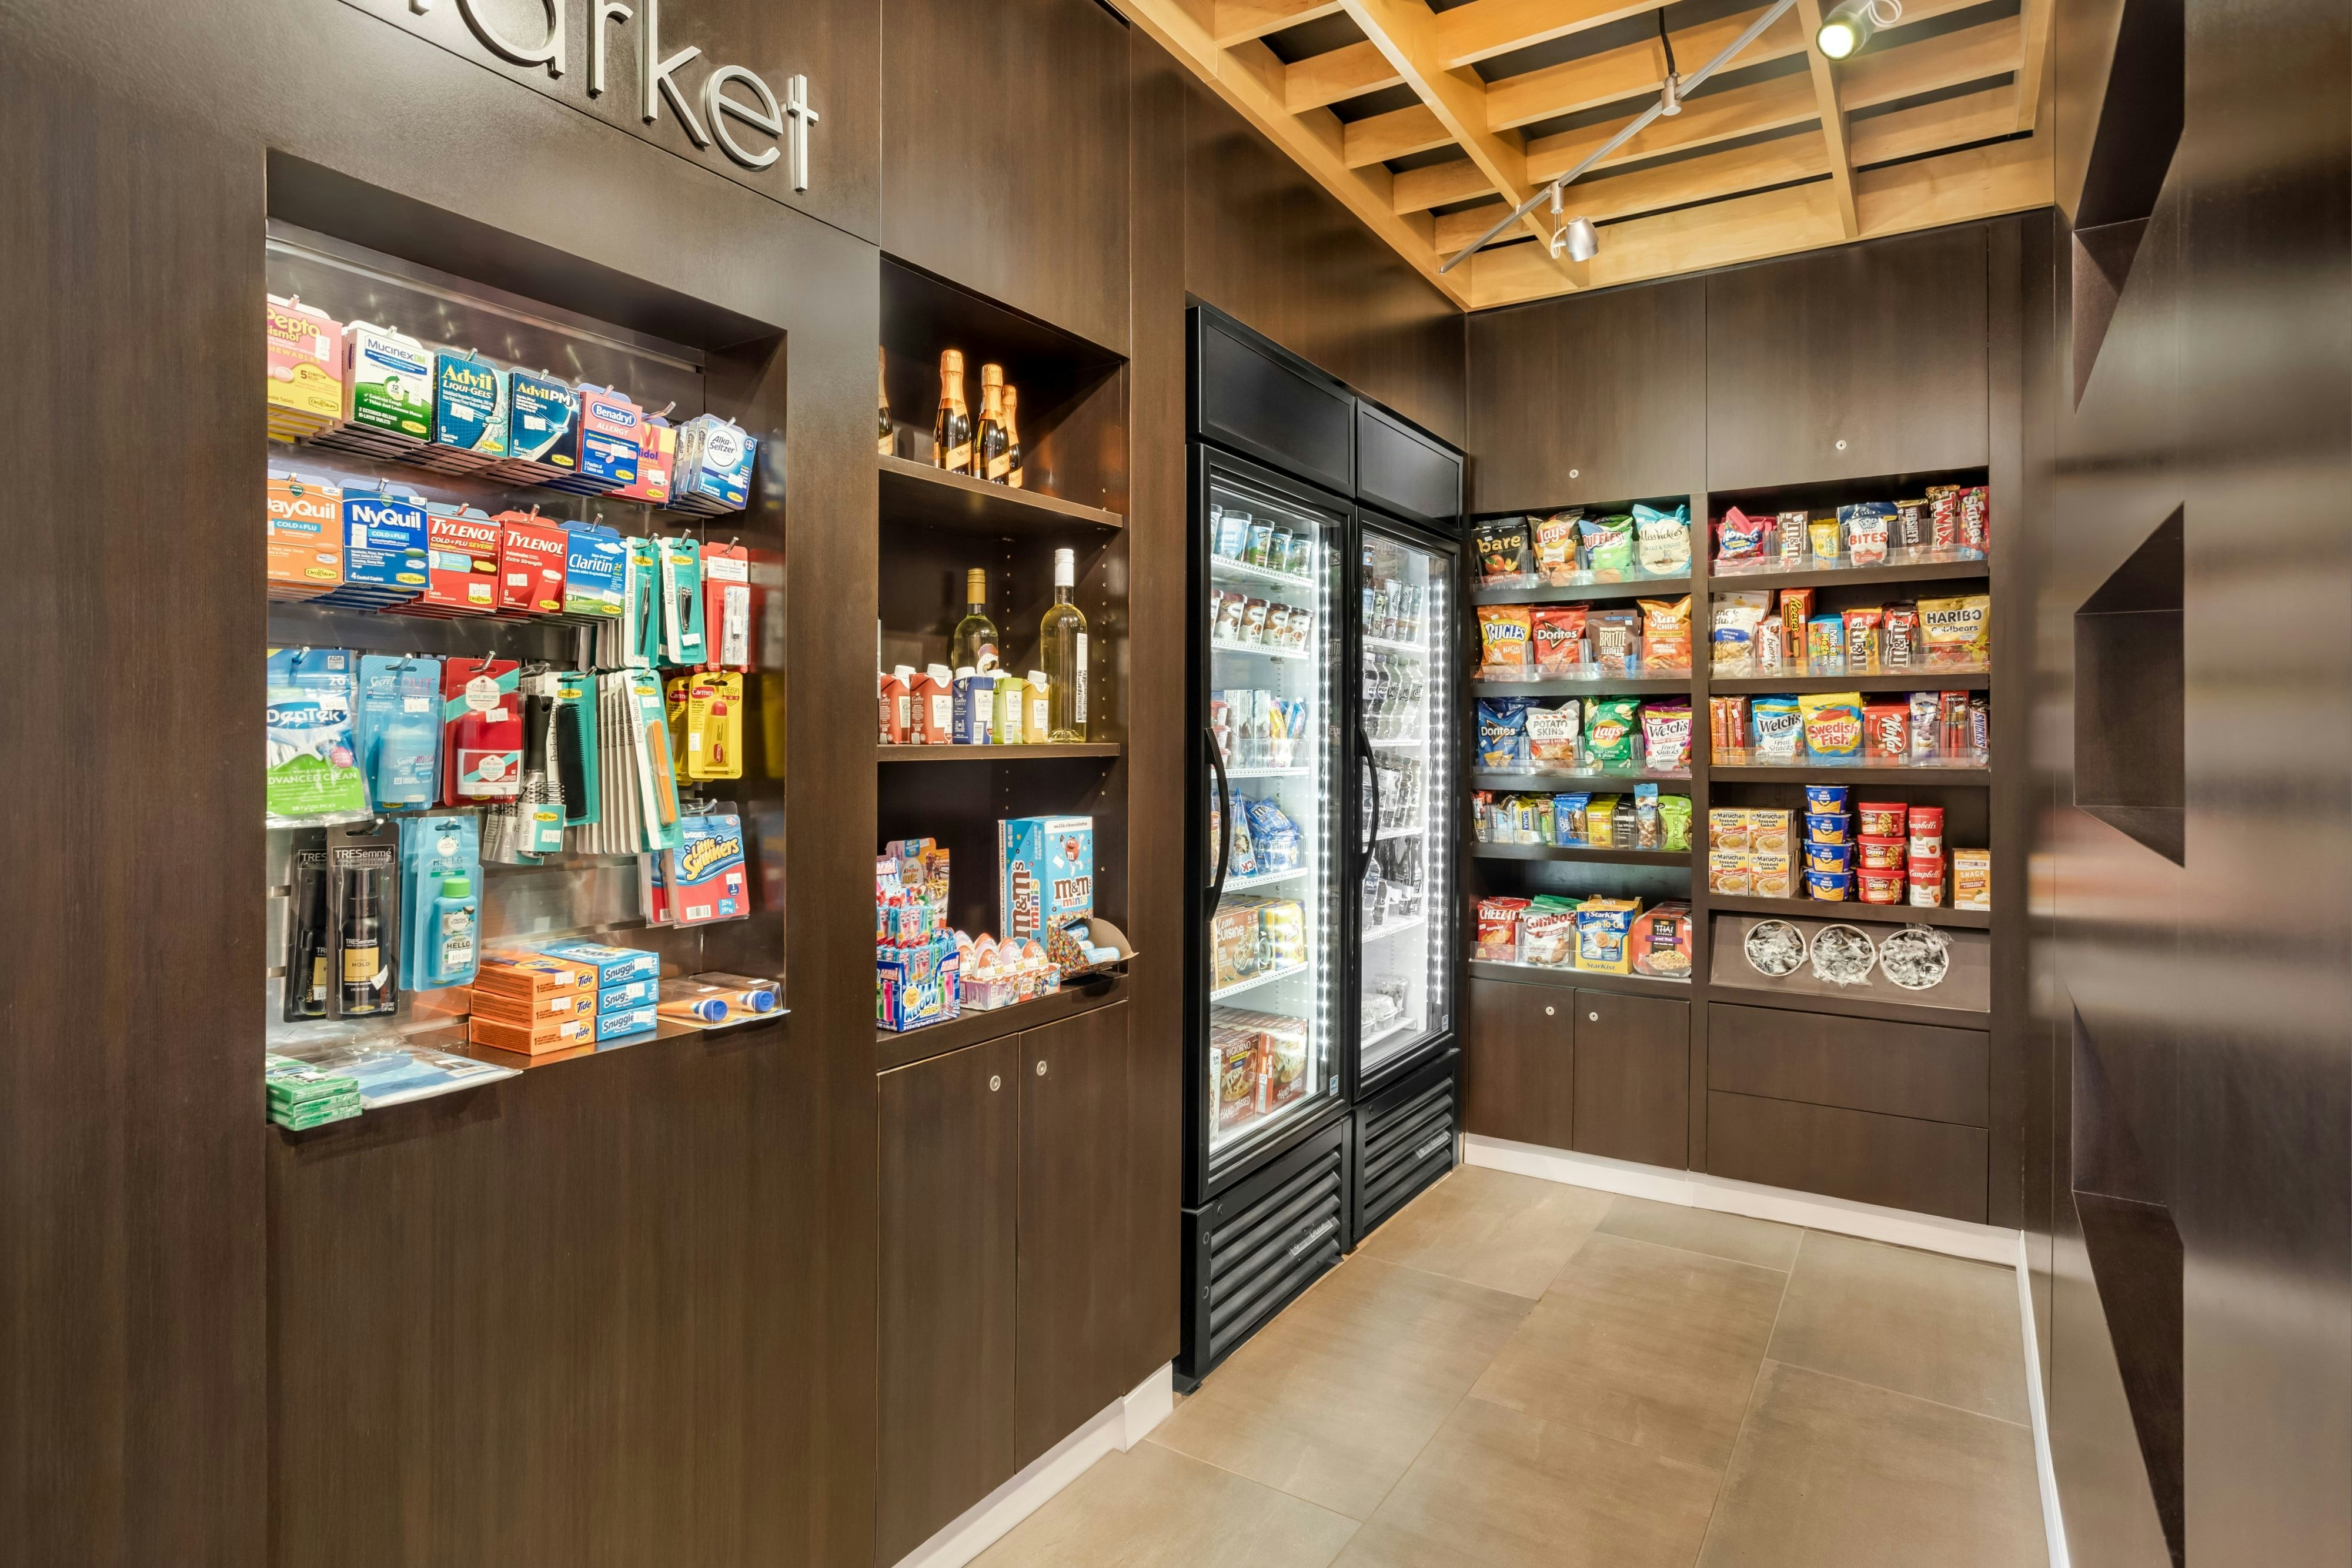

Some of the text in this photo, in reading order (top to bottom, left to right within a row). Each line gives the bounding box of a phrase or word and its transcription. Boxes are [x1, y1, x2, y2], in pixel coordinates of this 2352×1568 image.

[408, 0, 818, 191] arket
[368, 339, 414, 361] Mucinex
[414, 355, 426, 365] DM
[301, 370, 307, 379] 5
[442, 365, 492, 391] Advil
[516, 382, 549, 400] Advil
[550, 390, 570, 406] PM
[596, 405, 632, 426] Benadryl
[596, 423, 629, 436] ALLERGY
[709, 442, 735, 453] Seltzer
[712, 436, 731, 445] Alka-
[268, 498, 335, 519] ayQuil
[352, 504, 420, 530] NyQuil
[1905, 506, 1919, 544] HERSHEY'S
[1962, 496, 1981, 544] Skittles
[430, 518, 496, 542] TYLENOL
[1541, 525, 1566, 543] Lay's
[1658, 526, 1682, 540] Vickie's
[468, 542, 494, 550] SEVERE
[507, 530, 564, 554] TYLENOL
[1476, 536, 1521, 553] bare
[1583, 531, 1622, 549] RUFFLES
[1849, 531, 1887, 546] BITES
[569, 554, 612, 573] Claritin
[1651, 611, 1675, 627] Sun
[1927, 610, 1982, 624] HARIBO
[1484, 623, 1525, 645] BUGLES
[1538, 630, 1577, 640] Doritos
[1599, 631, 1626, 646] BRITTLE
[1829, 629, 1838, 652] Mike
[1768, 638, 1776, 663] bueno
[1820, 634, 1829, 656] Mega
[367, 676, 397, 688] Secret
[631, 698, 641, 720] Boards
[1481, 726, 1517, 736] Doritos
[1534, 720, 1568, 728] POTATO
[1648, 721, 1688, 737] Welch's
[1760, 714, 1801, 733] Welch's
[1807, 721, 1859, 738] Swedish
[1972, 713, 1986, 748] SNICKERS
[1594, 726, 1623, 740] Lay's
[1820, 733, 1850, 747] Fish
[395, 756, 416, 767] Secret
[268, 771, 357, 785] DVANCED CLEAN
[335, 848, 391, 858] TRESemmé
[1909, 869, 1940, 879] Campbell's
[1031, 880, 1039, 929] minis
[1062, 895, 1087, 908] minis
[1655, 925, 1674, 933] THAI
[578, 975, 593, 987] Tide
[577, 1001, 592, 1013] Tide
[921, 1005, 938, 1017] POPS
[603, 1012, 634, 1033] Snuggle
